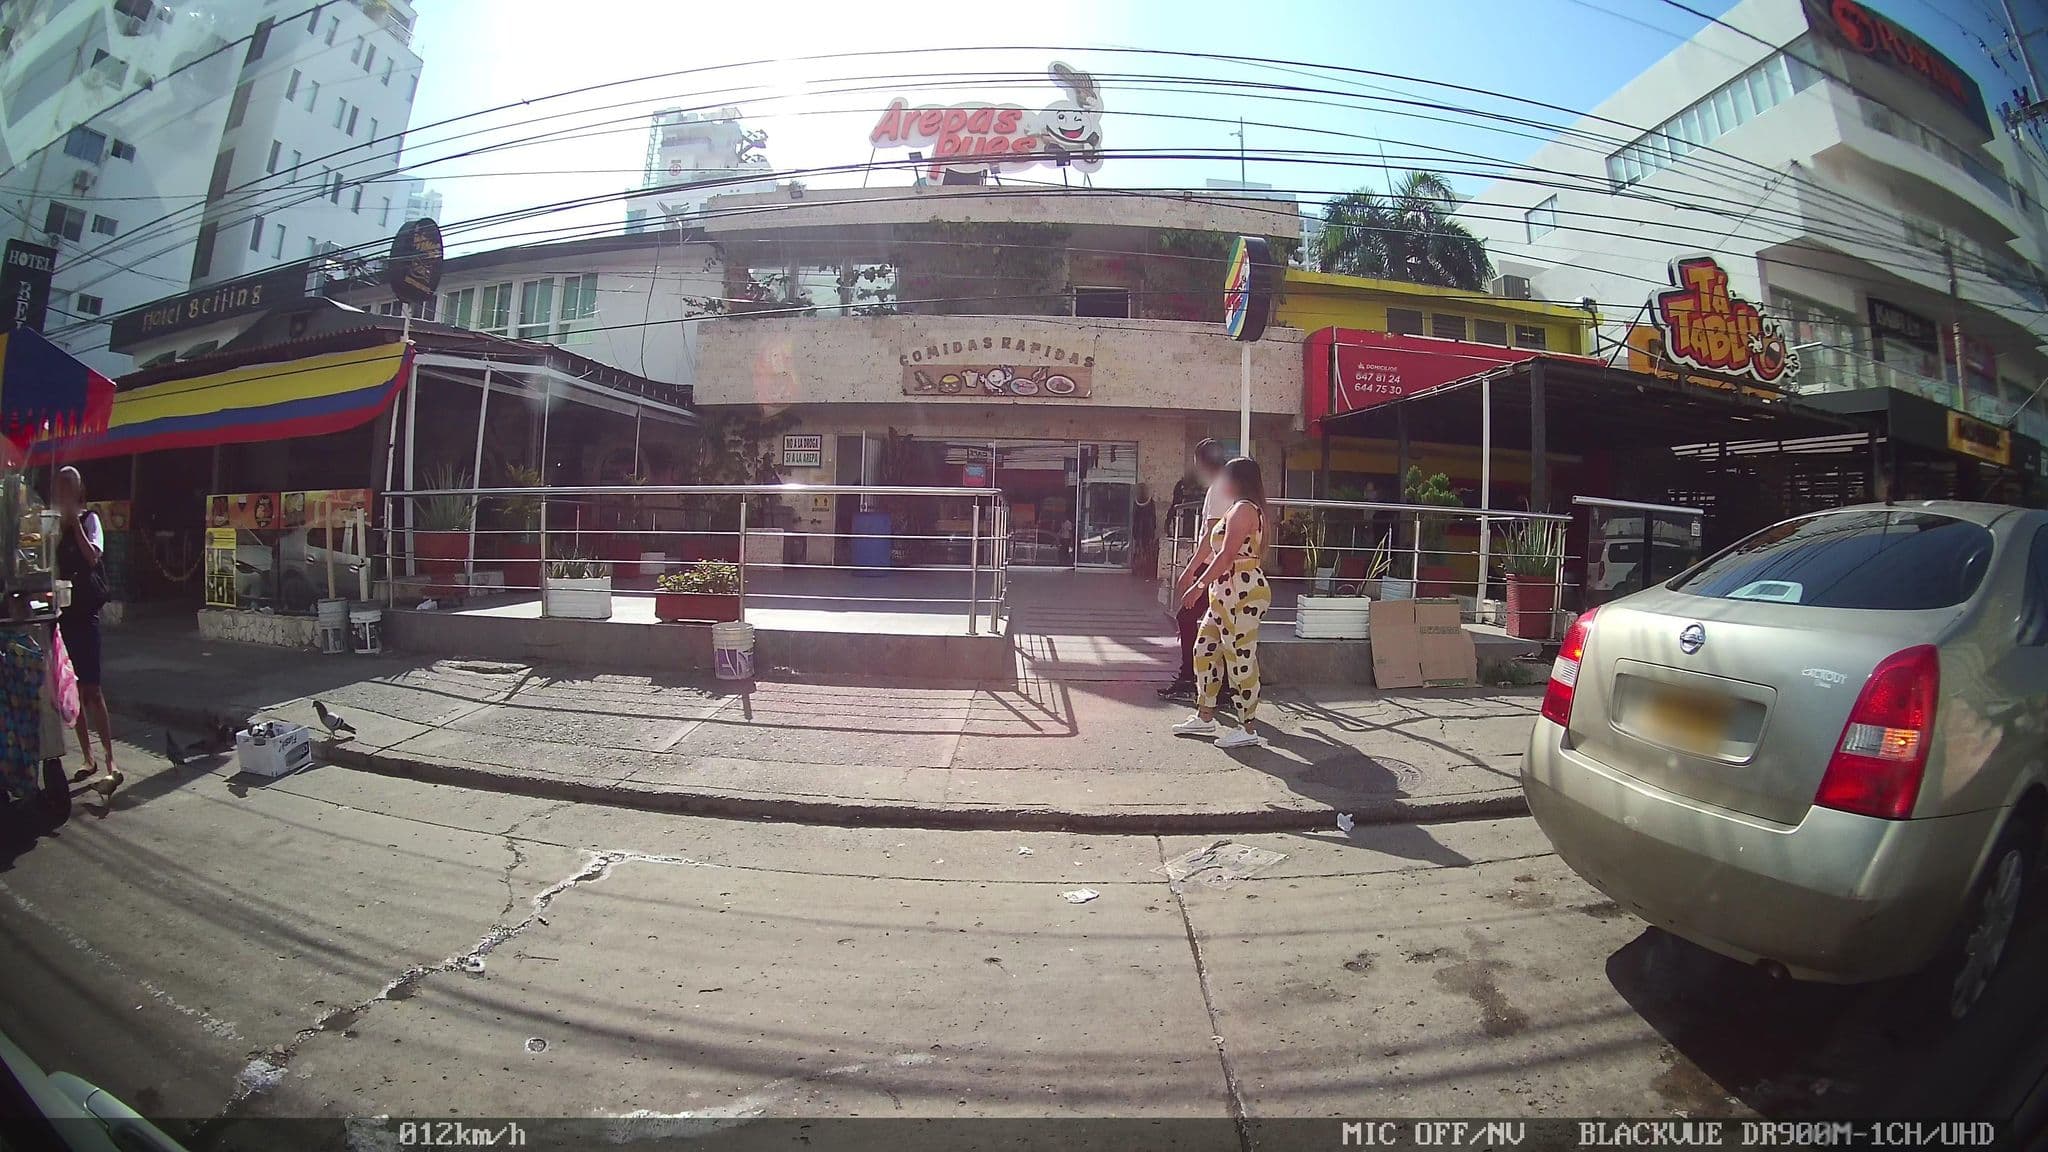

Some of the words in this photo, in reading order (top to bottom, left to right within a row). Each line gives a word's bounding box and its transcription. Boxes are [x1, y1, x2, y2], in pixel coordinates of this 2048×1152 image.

[871, 101, 1023, 142] Arepas
[928, 133, 1040, 181] pues
[8, 250, 53, 273] HOTEL
[142, 303, 182, 333] Hotel
[188, 284, 263, 319] Beijing
[899, 336, 994, 366] COMIDAS
[1354, 383, 1374, 393] 644
[1375, 384, 1388, 394] 75
[1389, 386, 1403, 395] 30
[1355, 371, 1374, 382] 647
[1375, 373, 1387, 383] 81
[1388, 375, 1401, 384] 24
[785, 437, 793, 449] NO
[797, 437, 803, 449] LA
[796, 452, 802, 464] LA
[803, 452, 818, 464] AREPA
